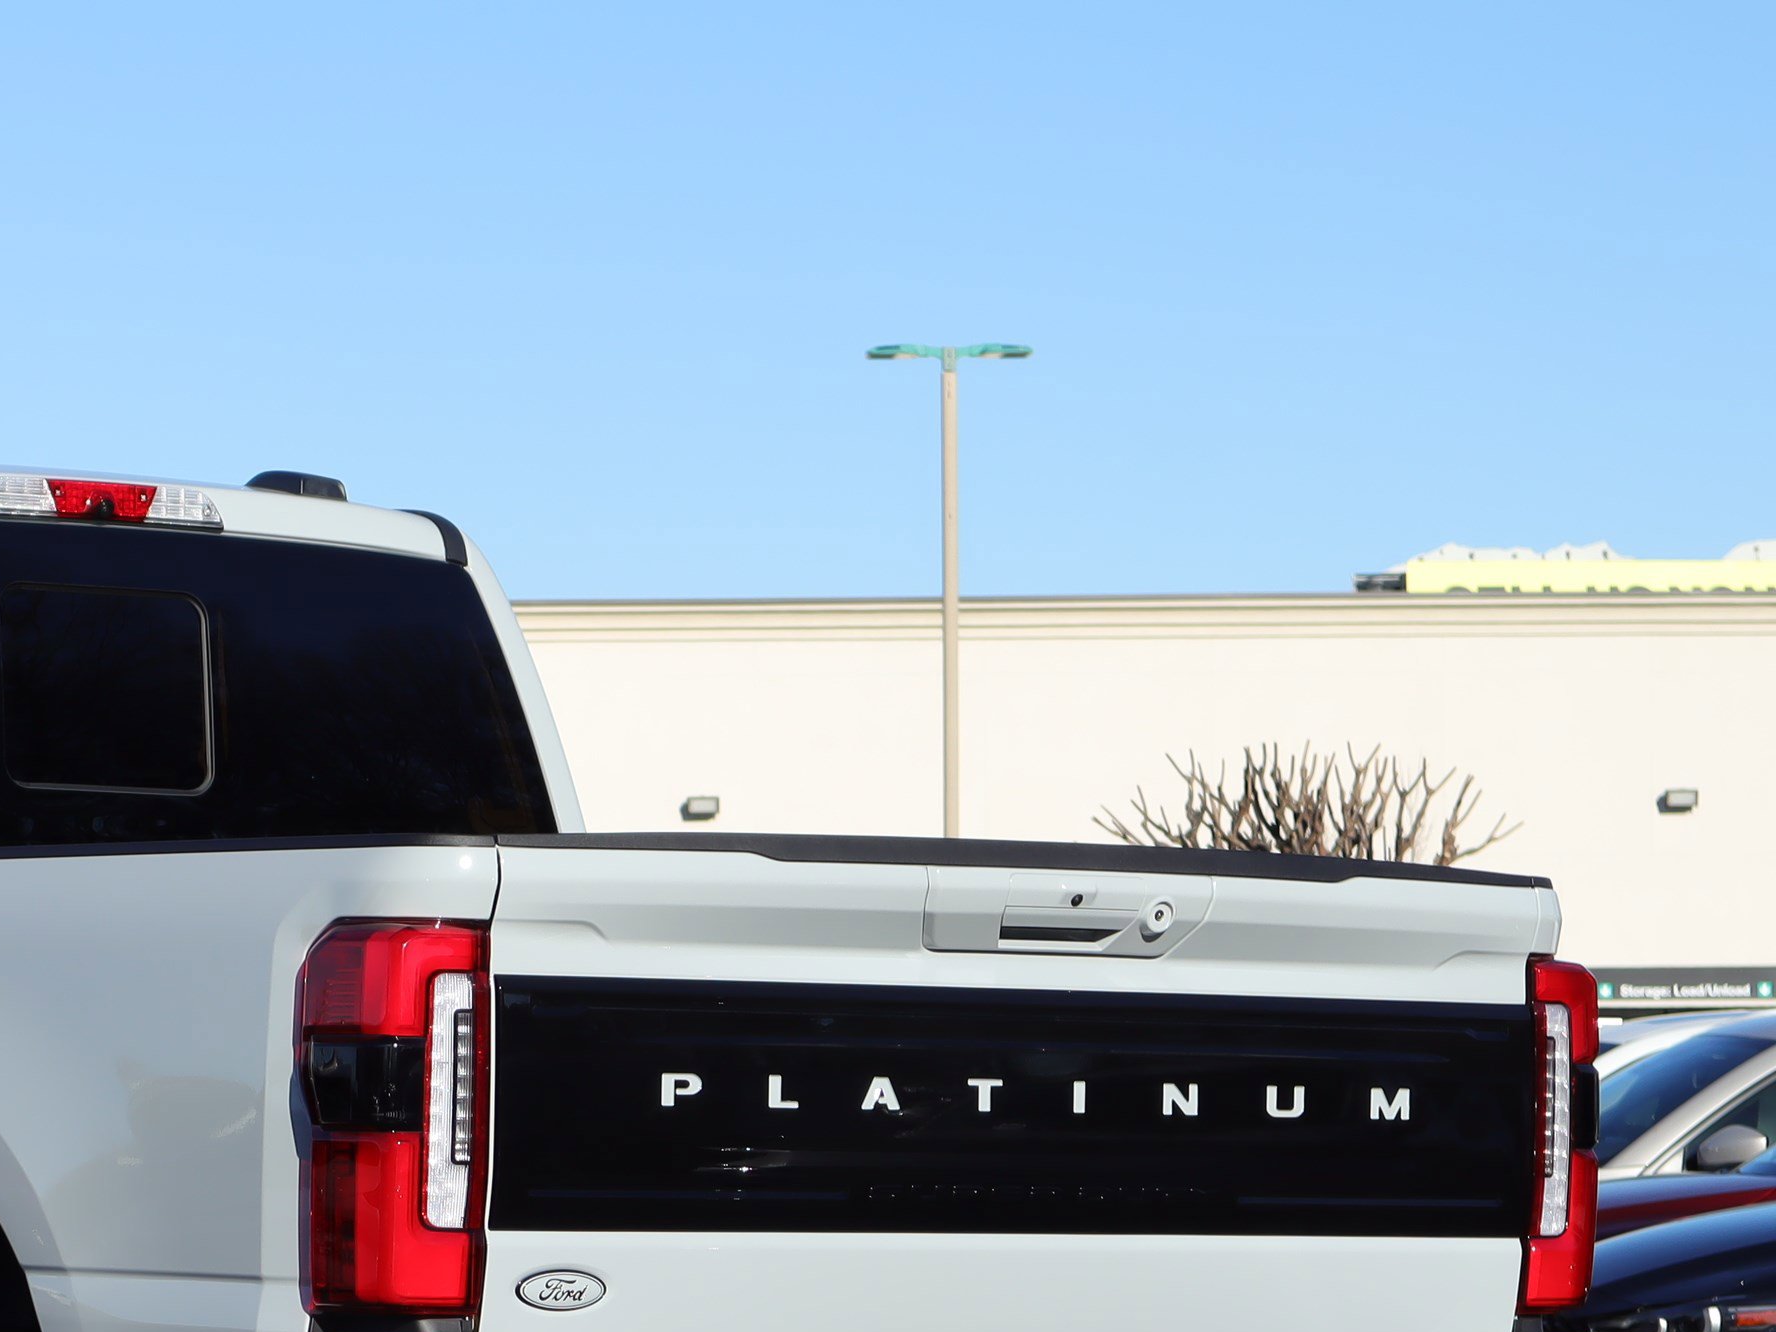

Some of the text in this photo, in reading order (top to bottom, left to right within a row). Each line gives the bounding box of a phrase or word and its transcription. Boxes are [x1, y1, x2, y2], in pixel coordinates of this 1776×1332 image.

[1673, 983, 1751, 998] Load/Unload
[660, 1072, 1411, 1121] PLATINUM
[538, 1277, 589, 1302] Ford
